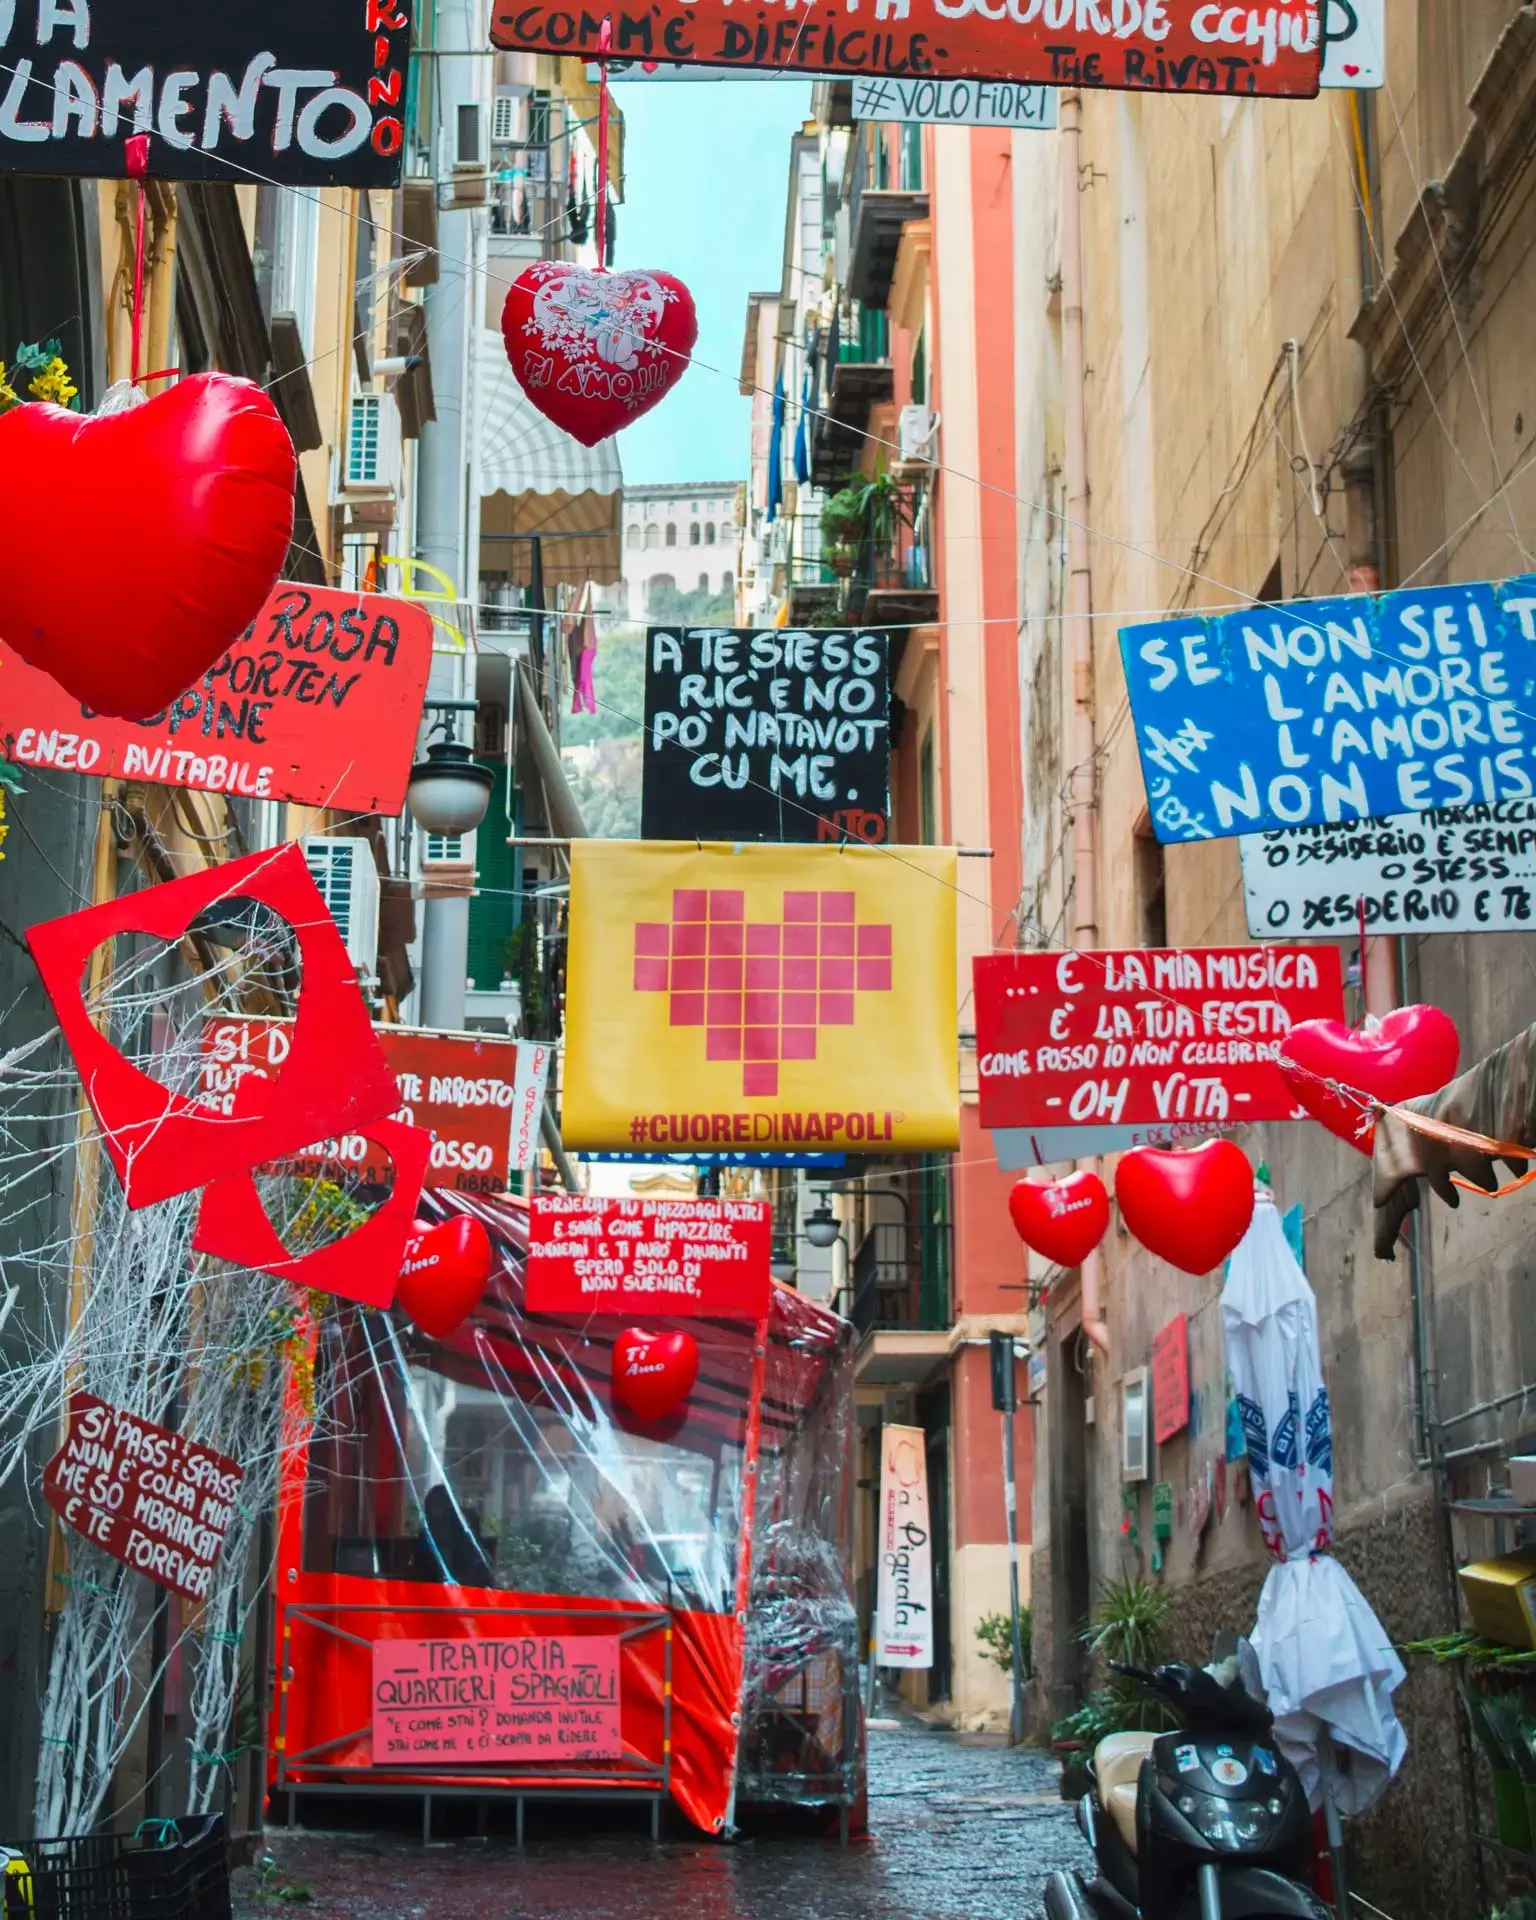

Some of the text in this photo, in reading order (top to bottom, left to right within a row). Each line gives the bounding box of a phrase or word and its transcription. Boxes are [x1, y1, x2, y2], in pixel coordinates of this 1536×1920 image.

[0, 51, 373, 159] LAMENTO
[524, 350, 554, 385] TI
[652, 628, 881, 677] A TE STESS
[1139, 635, 1222, 692] SE
[1242, 616, 1372, 672] NON
[1399, 590, 1488, 660] SEI
[803, 674, 876, 714] NO
[1277, 699, 1525, 769] L'AMORE
[15, 729, 275, 797] ENZO AVITABILE
[690, 752, 750, 790] CU
[1210, 761, 1371, 829] NON
[1397, 747, 1536, 811] ESIS
[1302, 887, 1460, 931] DESIDERIO
[1500, 885, 1532, 921] TE
[1104, 954, 1149, 992] LA
[1154, 949, 1200, 989] MIA
[1207, 949, 1319, 990] MUSICA
[1092, 1003, 1134, 1041] LA
[1135, 1001, 1196, 1038] TUA
[1202, 1000, 1292, 1036] FESTA
[267, 1027, 292, 1066] D
[979, 1049, 1031, 1078] COME
[428, 1076, 516, 1108] ARROSTO
[616, 1198, 640, 1216] TU
[580, 1275, 618, 1293] NON
[633, 1258, 679, 1277] SOLO
[55, 1458, 90, 1496] ME
[89, 1473, 126, 1511] SO
[67, 1439, 115, 1475] NUN
[138, 1469, 196, 1512] COLPA
[200, 1496, 233, 1532] MIA
[88, 1506, 116, 1542] TE
[124, 1528, 213, 1600] FOREVER
[376, 1674, 496, 1705] QUARTIERI
